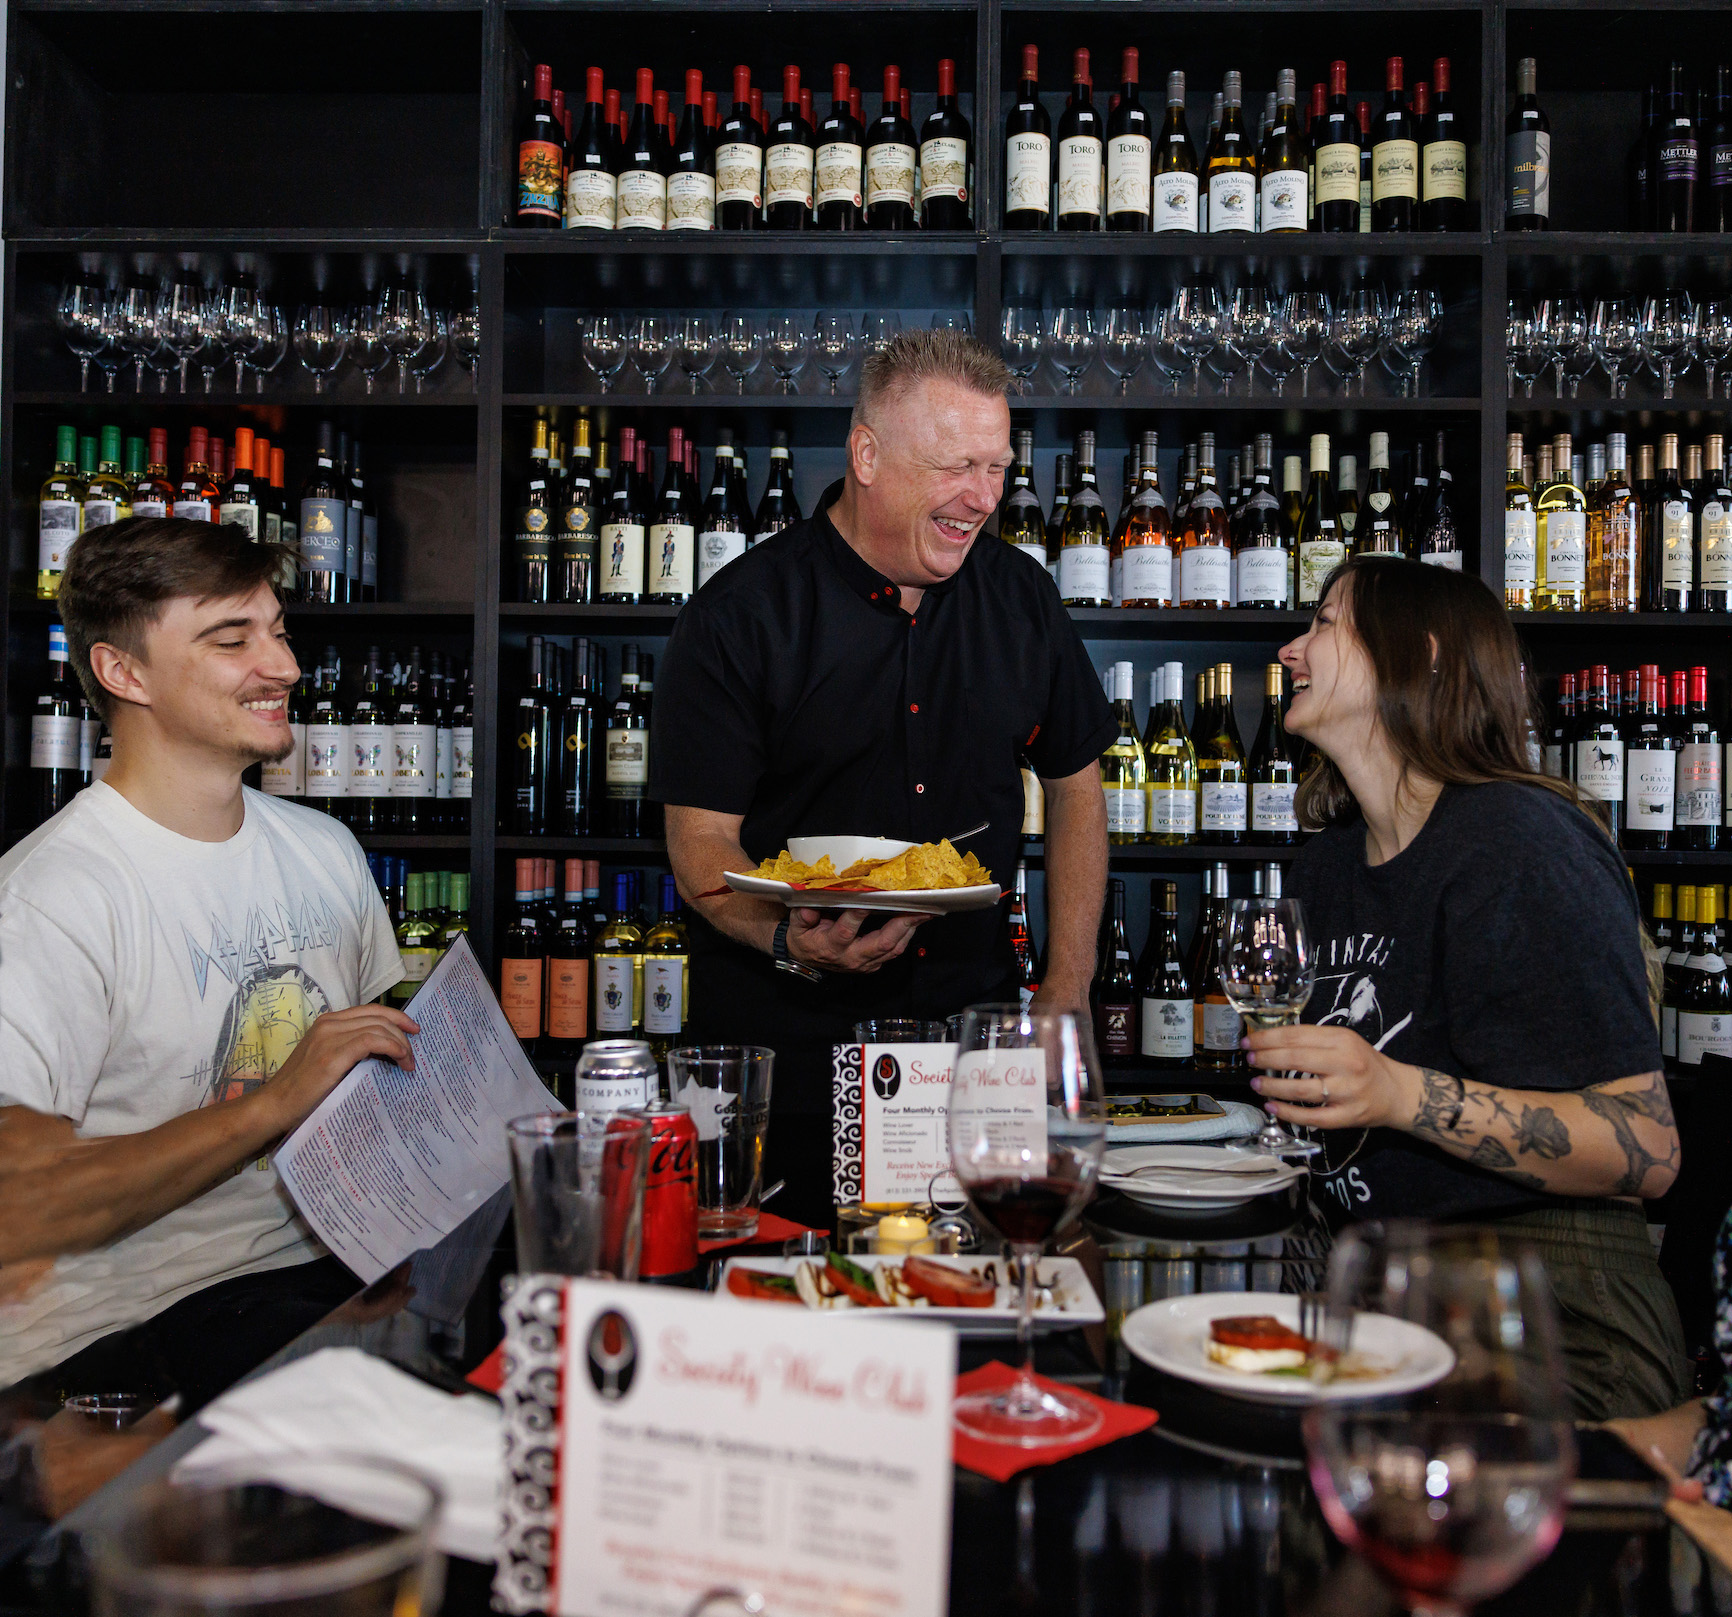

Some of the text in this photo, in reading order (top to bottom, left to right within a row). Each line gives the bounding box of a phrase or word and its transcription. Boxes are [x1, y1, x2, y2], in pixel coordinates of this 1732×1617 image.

[1016, 141, 1042, 152] TORO
[1068, 144, 1096, 154] TORO
[1118, 144, 1144, 154] TORO
[1660, 146, 1698, 158] METTLER
[558, 532, 598, 540] BARBARESCO
[1504, 552, 1534, 561] BONNET
[1550, 553, 1584, 562] BONNET
[1602, 552, 1638, 561] BONNT
[308, 769, 341, 777] LOBETIA
[351, 769, 384, 777] LOBETIA
[392, 769, 424, 777] LOBETIA
[1640, 774, 1672, 783] GRAND
[970, 1067, 1001, 1088] Wine
[1004, 1066, 1036, 1087] Club
[582, 1087, 640, 1097] COMPANY
[883, 1106, 900, 1114] Four
[903, 1106, 935, 1115] Monthly
[985, 1106, 1011, 1114] Choose
[916, 1161, 934, 1170] New
[896, 1171, 918, 1180] Enjoy
